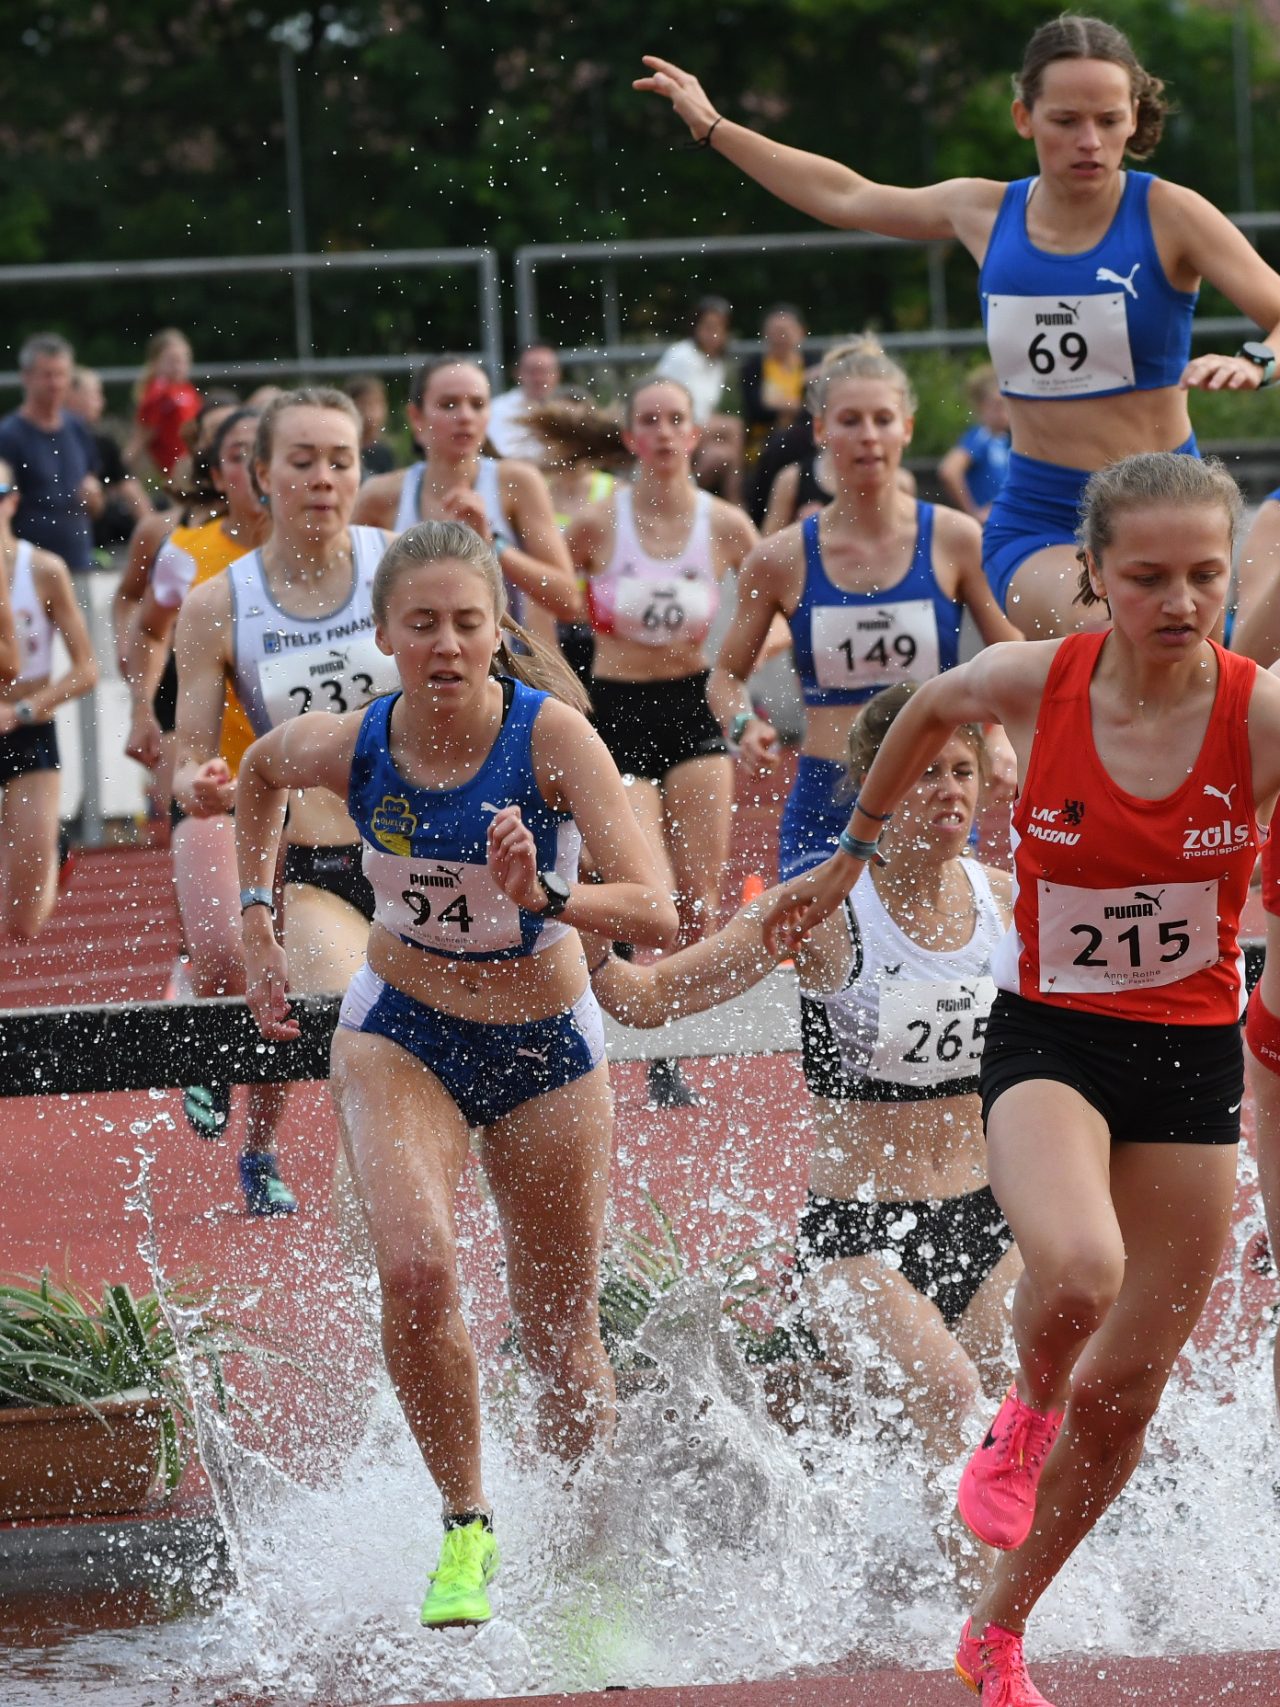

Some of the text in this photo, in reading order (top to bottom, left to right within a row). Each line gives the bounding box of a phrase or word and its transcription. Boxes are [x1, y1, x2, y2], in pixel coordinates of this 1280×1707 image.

[1035, 313, 1073, 326] PUMA
[1028, 332, 1088, 375] 69
[642, 604, 684, 631] 60
[283, 631, 322, 648] TELIS
[838, 634, 917, 672] 149
[308, 660, 344, 677] PUMA
[1031, 806, 1061, 822] LAC
[1027, 822, 1081, 846] PASSAU
[410, 873, 454, 889] PUMA
[402, 890, 474, 933] 94
[1104, 903, 1154, 919] PUMA
[1070, 919, 1190, 967] 215
[1133, 970, 1161, 978] Rothe
[902, 1016, 989, 1063] 265
